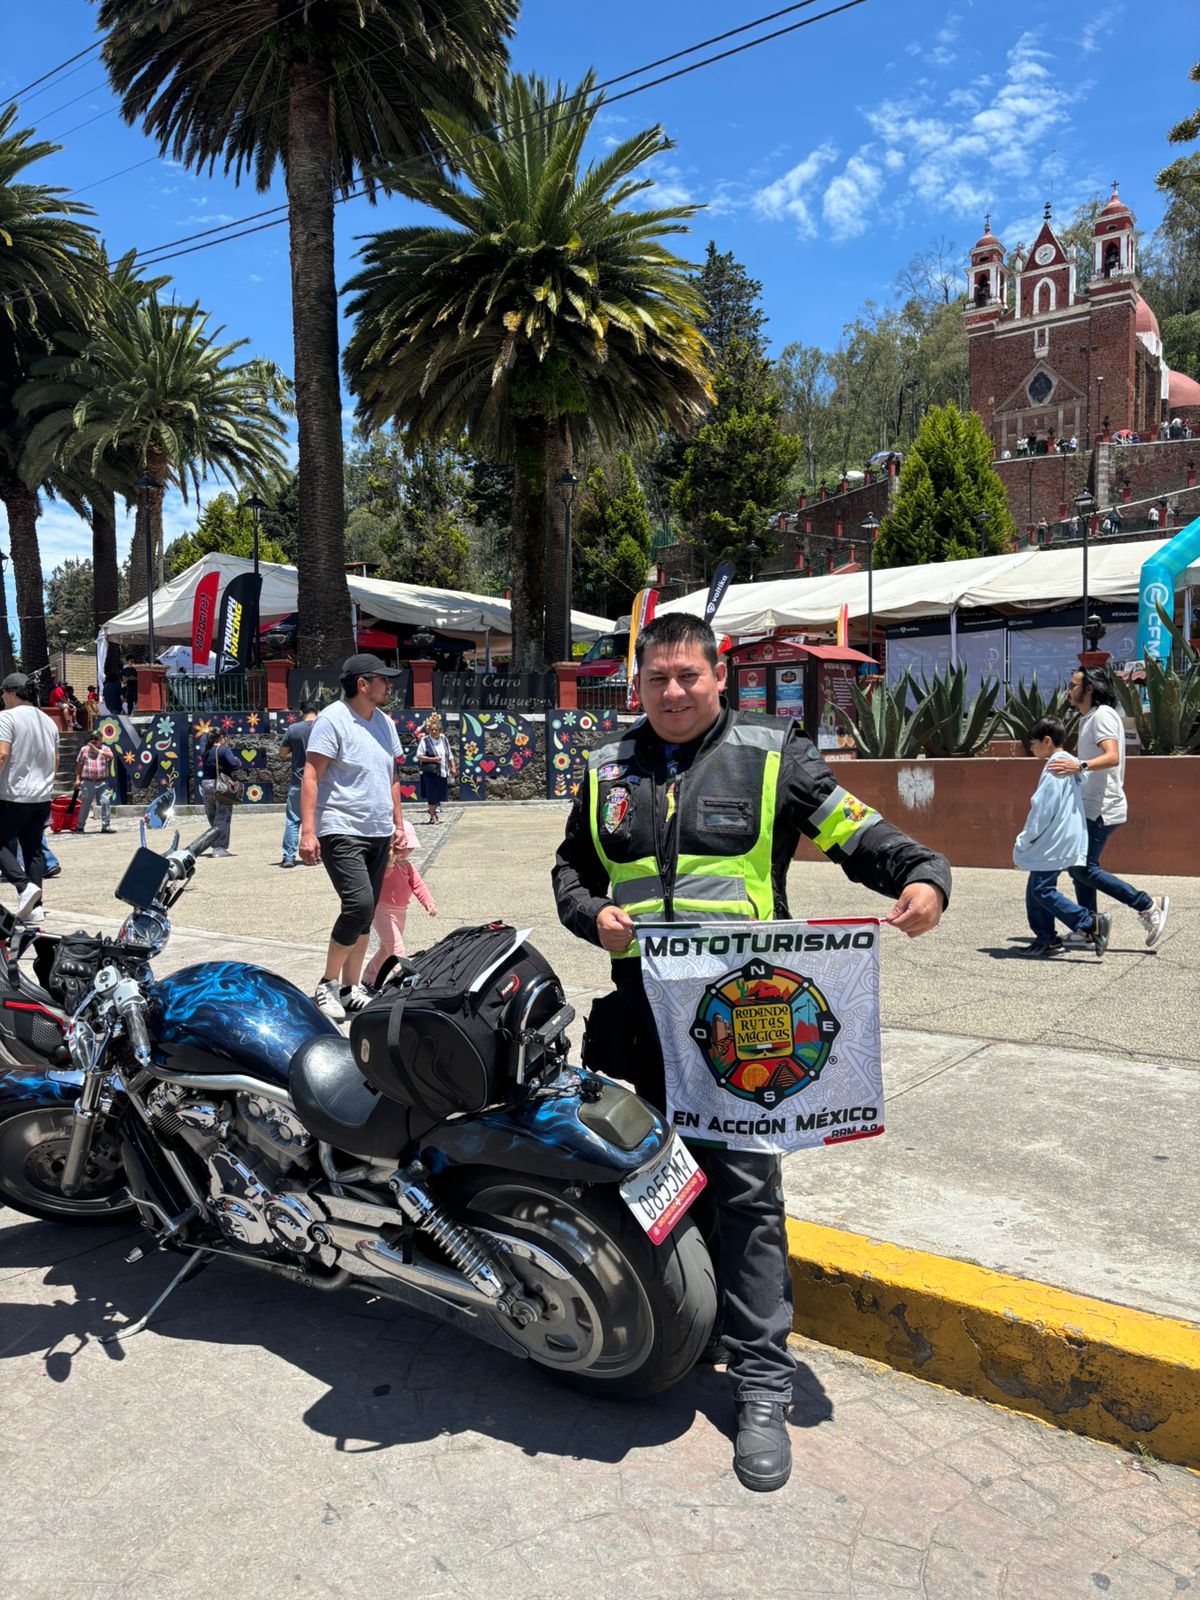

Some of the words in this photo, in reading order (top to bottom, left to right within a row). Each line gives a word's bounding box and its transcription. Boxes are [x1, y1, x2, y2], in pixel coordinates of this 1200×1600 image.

[712, 575, 728, 602] voltika
[224, 595, 239, 652] TRIUMPH
[230, 603, 242, 657] RACING
[442, 674, 461, 687] En
[465, 674, 478, 687] el
[482, 674, 521, 688] Cerro
[441, 694, 456, 706] de
[461, 693, 480, 706] los
[645, 931, 875, 957] MOTOTURISMO
[750, 965, 765, 975] N
[694, 1028, 707, 1039] O
[822, 1021, 834, 1032] E
[763, 1091, 776, 1102] S
[673, 1110, 699, 1128] EN
[708, 1113, 786, 1136] ACCIÓN
[796, 1106, 878, 1132] MÉXICO
[832, 1126, 856, 1138] RRM
[638, 1149, 692, 1221] 0855M7
